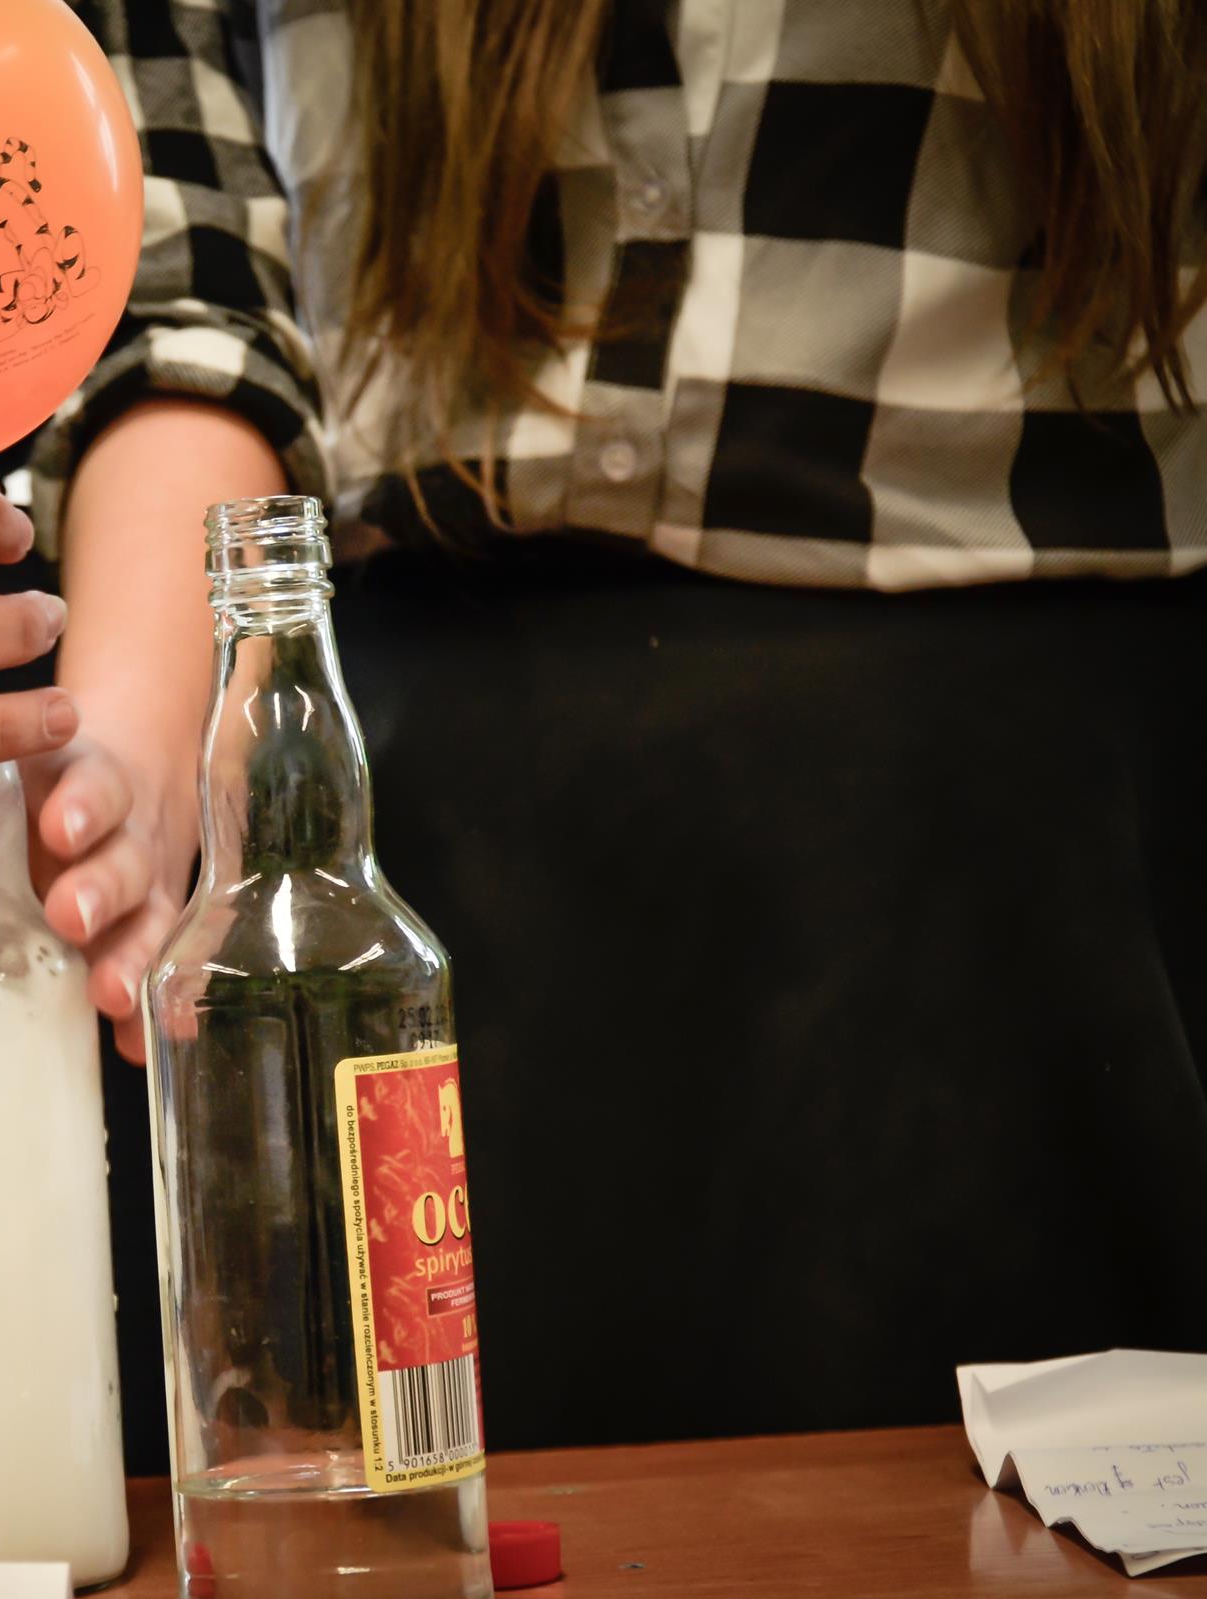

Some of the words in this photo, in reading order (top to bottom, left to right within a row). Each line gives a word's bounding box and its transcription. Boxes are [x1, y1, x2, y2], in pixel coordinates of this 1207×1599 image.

[376, 1060, 399, 1071] PEGAZ
[346, 1104, 355, 1118] do
[347, 1120, 362, 1198] bezpośredniego
[353, 1200, 364, 1242] spożycia
[357, 1244, 367, 1280] używać
[360, 1282, 368, 1291] w
[361, 1295, 370, 1322] stanie
[363, 1324, 377, 1397] rozcieńczonym
[369, 1399, 377, 1408] w
[370, 1410, 382, 1455] stosunku
[388, 1461, 395, 1472] 5
[403, 1452, 445, 1470] 901658
[385, 1472, 407, 1483] Data
